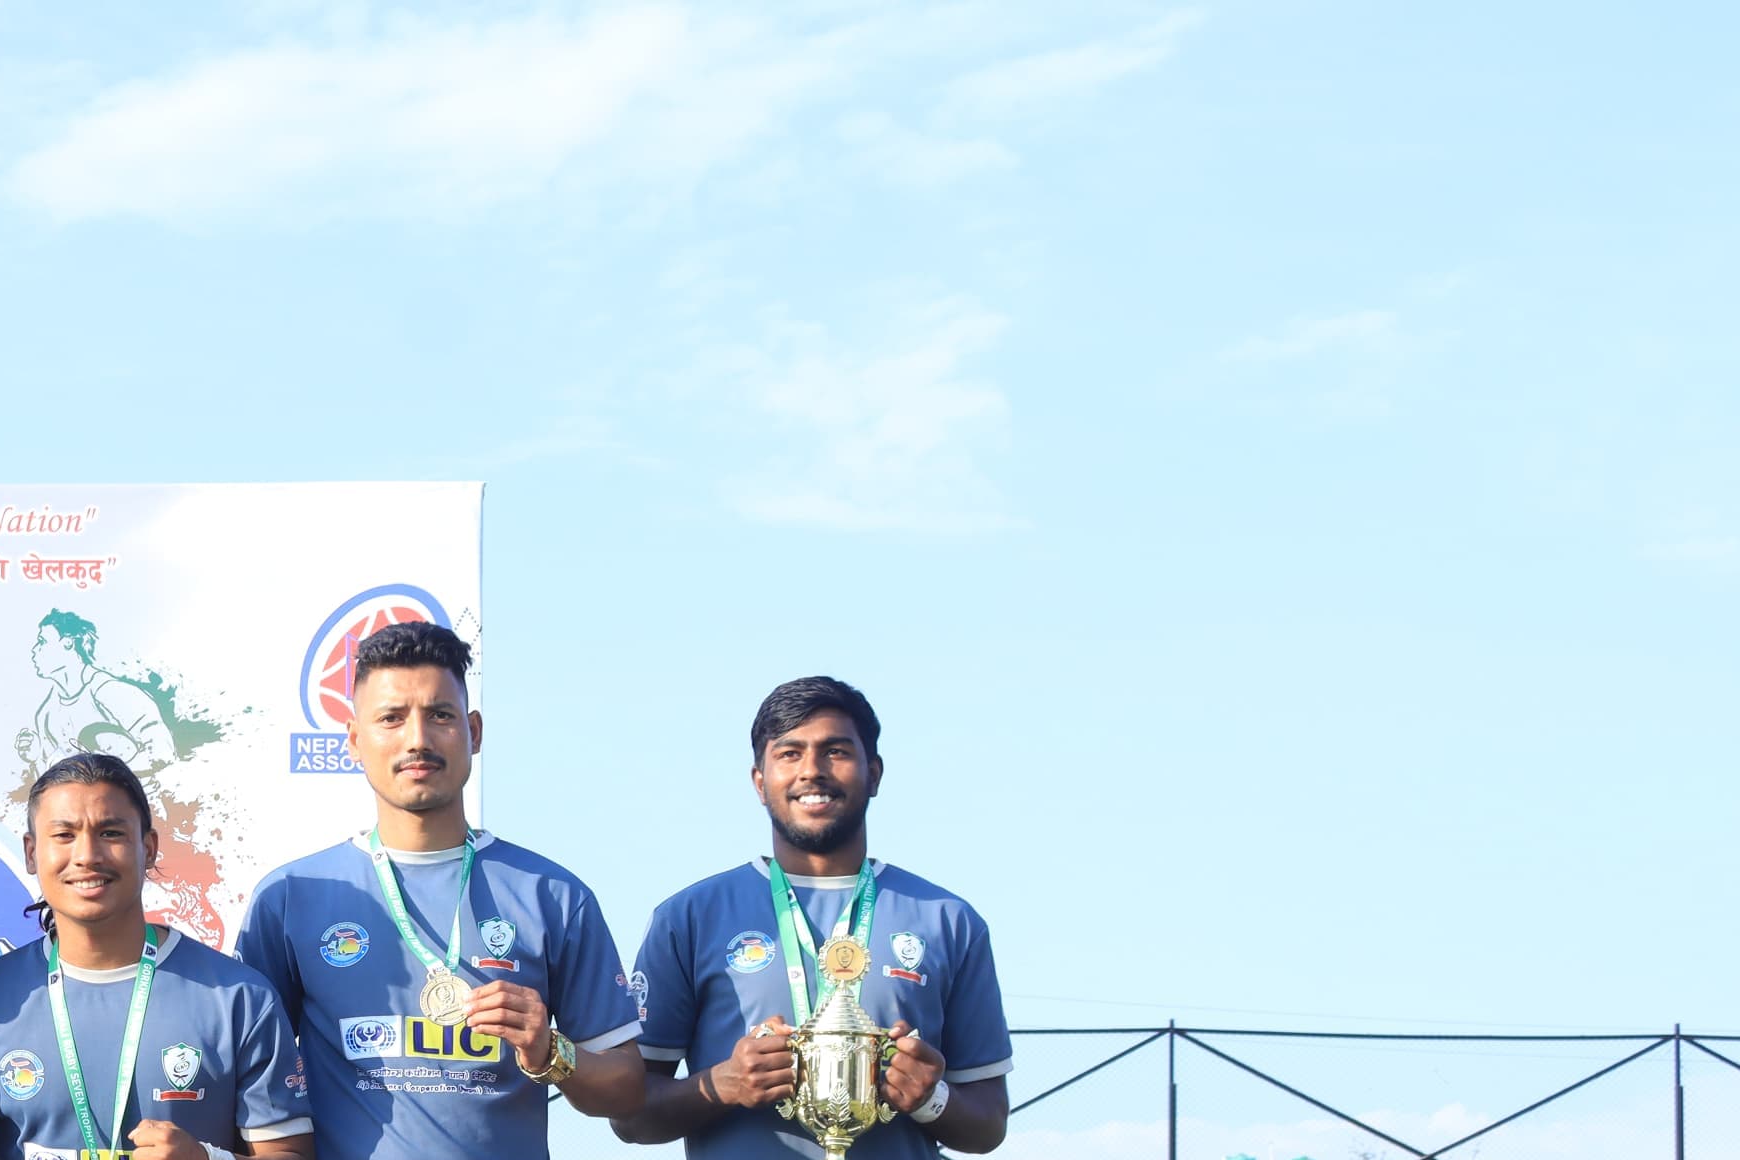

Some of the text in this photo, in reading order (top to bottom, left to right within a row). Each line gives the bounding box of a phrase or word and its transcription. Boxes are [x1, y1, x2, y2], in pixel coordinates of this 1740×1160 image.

[412, 1021, 493, 1058] LIC
[69, 1072, 85, 1106] SEVEN
[403, 1081, 457, 1095] Corporation
